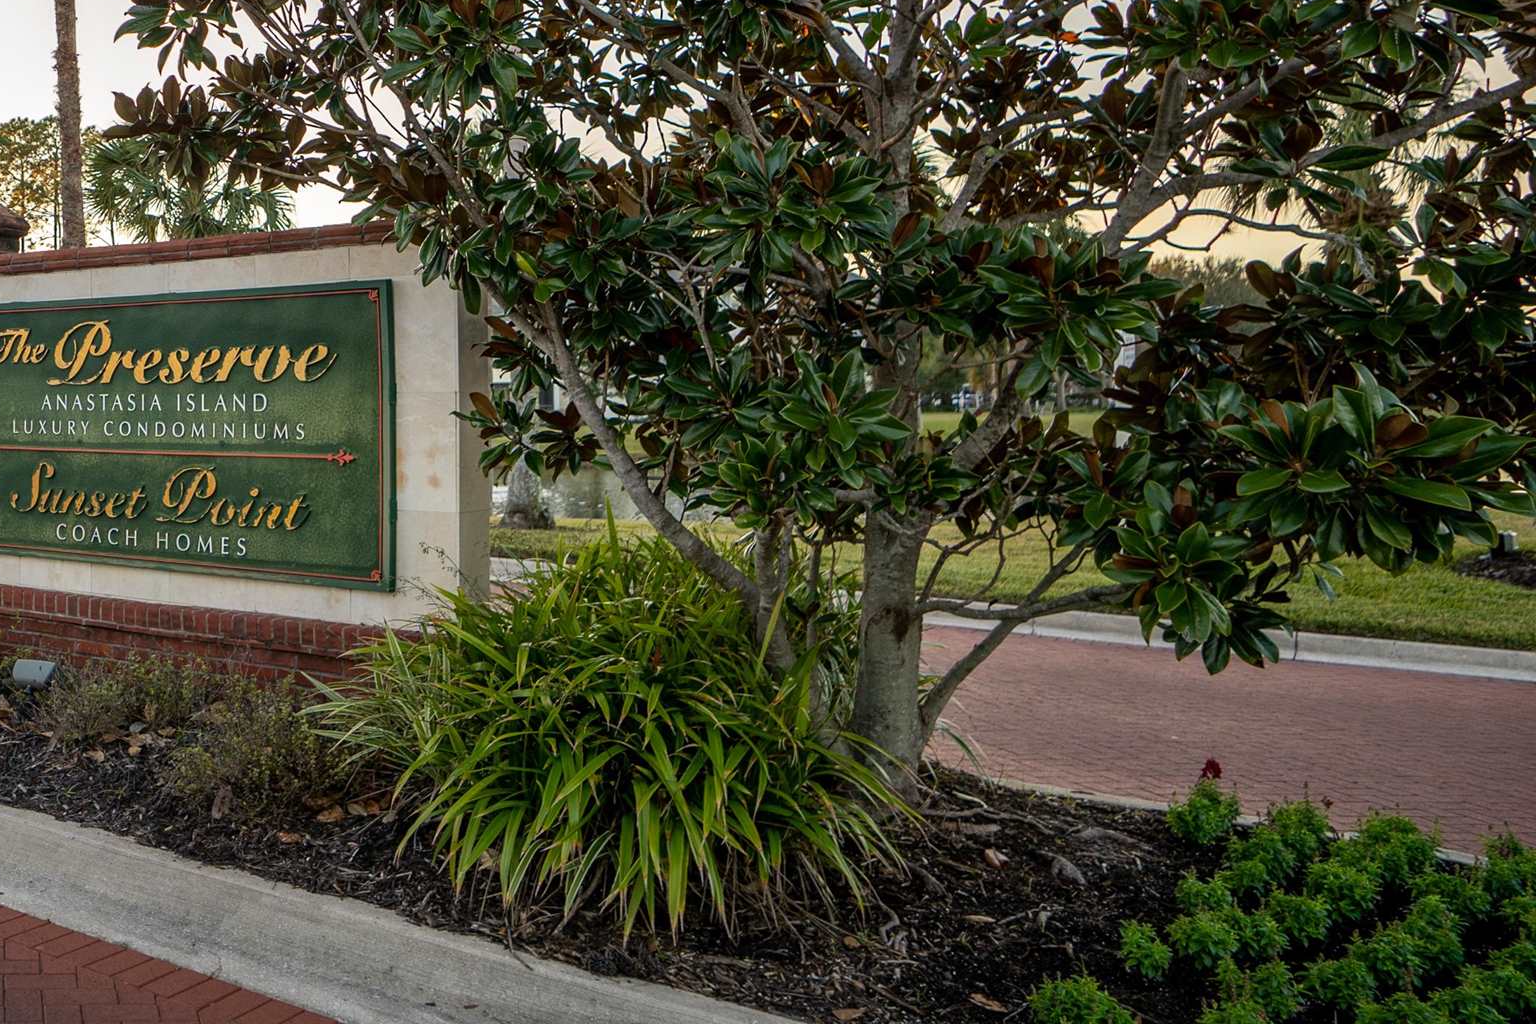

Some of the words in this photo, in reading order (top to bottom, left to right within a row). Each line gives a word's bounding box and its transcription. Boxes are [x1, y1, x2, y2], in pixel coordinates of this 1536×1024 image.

[47, 319, 337, 386] Preserve
[40, 392, 162, 412] ANASTASIA
[176, 392, 268, 413] ISLAND
[11, 418, 90, 436] LUXURY
[103, 420, 306, 441] CONDOMINIUMS
[10, 461, 149, 520] Sunset
[155, 464, 312, 532] Point
[56, 523, 138, 548] COACH
[156, 530, 247, 557] HOMES
